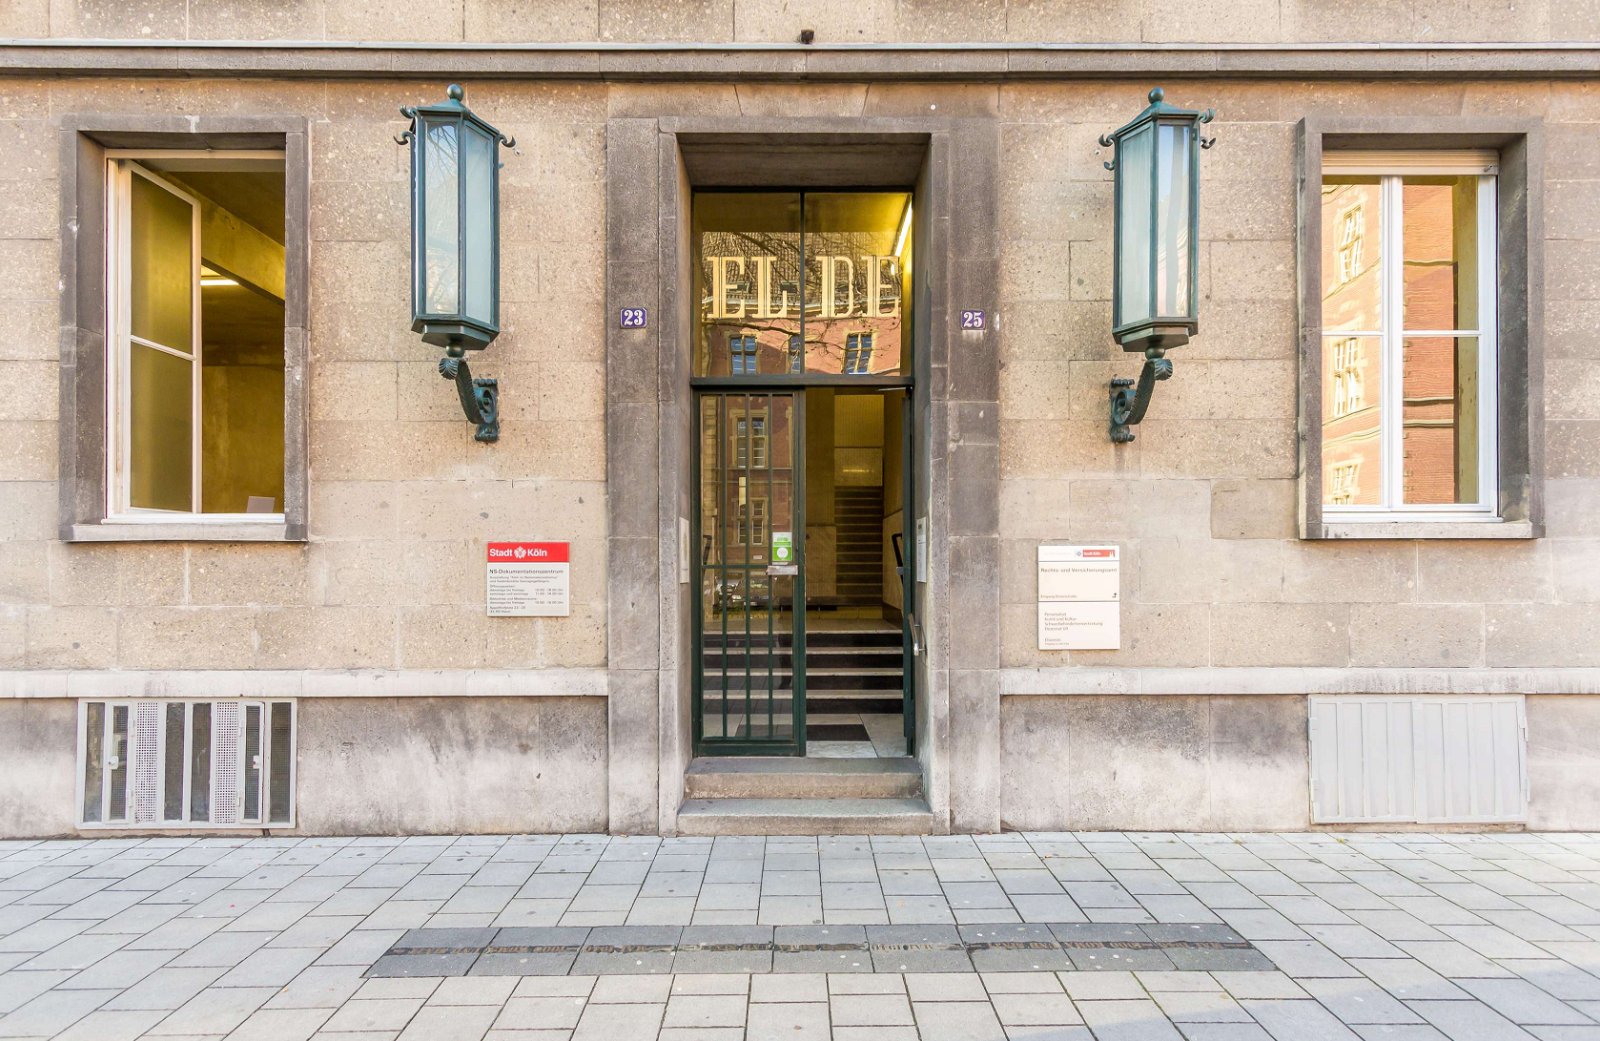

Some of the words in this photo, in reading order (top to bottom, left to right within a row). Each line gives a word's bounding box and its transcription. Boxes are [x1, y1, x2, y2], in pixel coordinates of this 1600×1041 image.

[706, 255, 788, 319] EL
[814, 255, 901, 319] DE
[623, 309, 644, 326] 23
[963, 311, 983, 328] 25
[489, 548, 513, 557] Stadt
[527, 548, 548, 557] Köln
